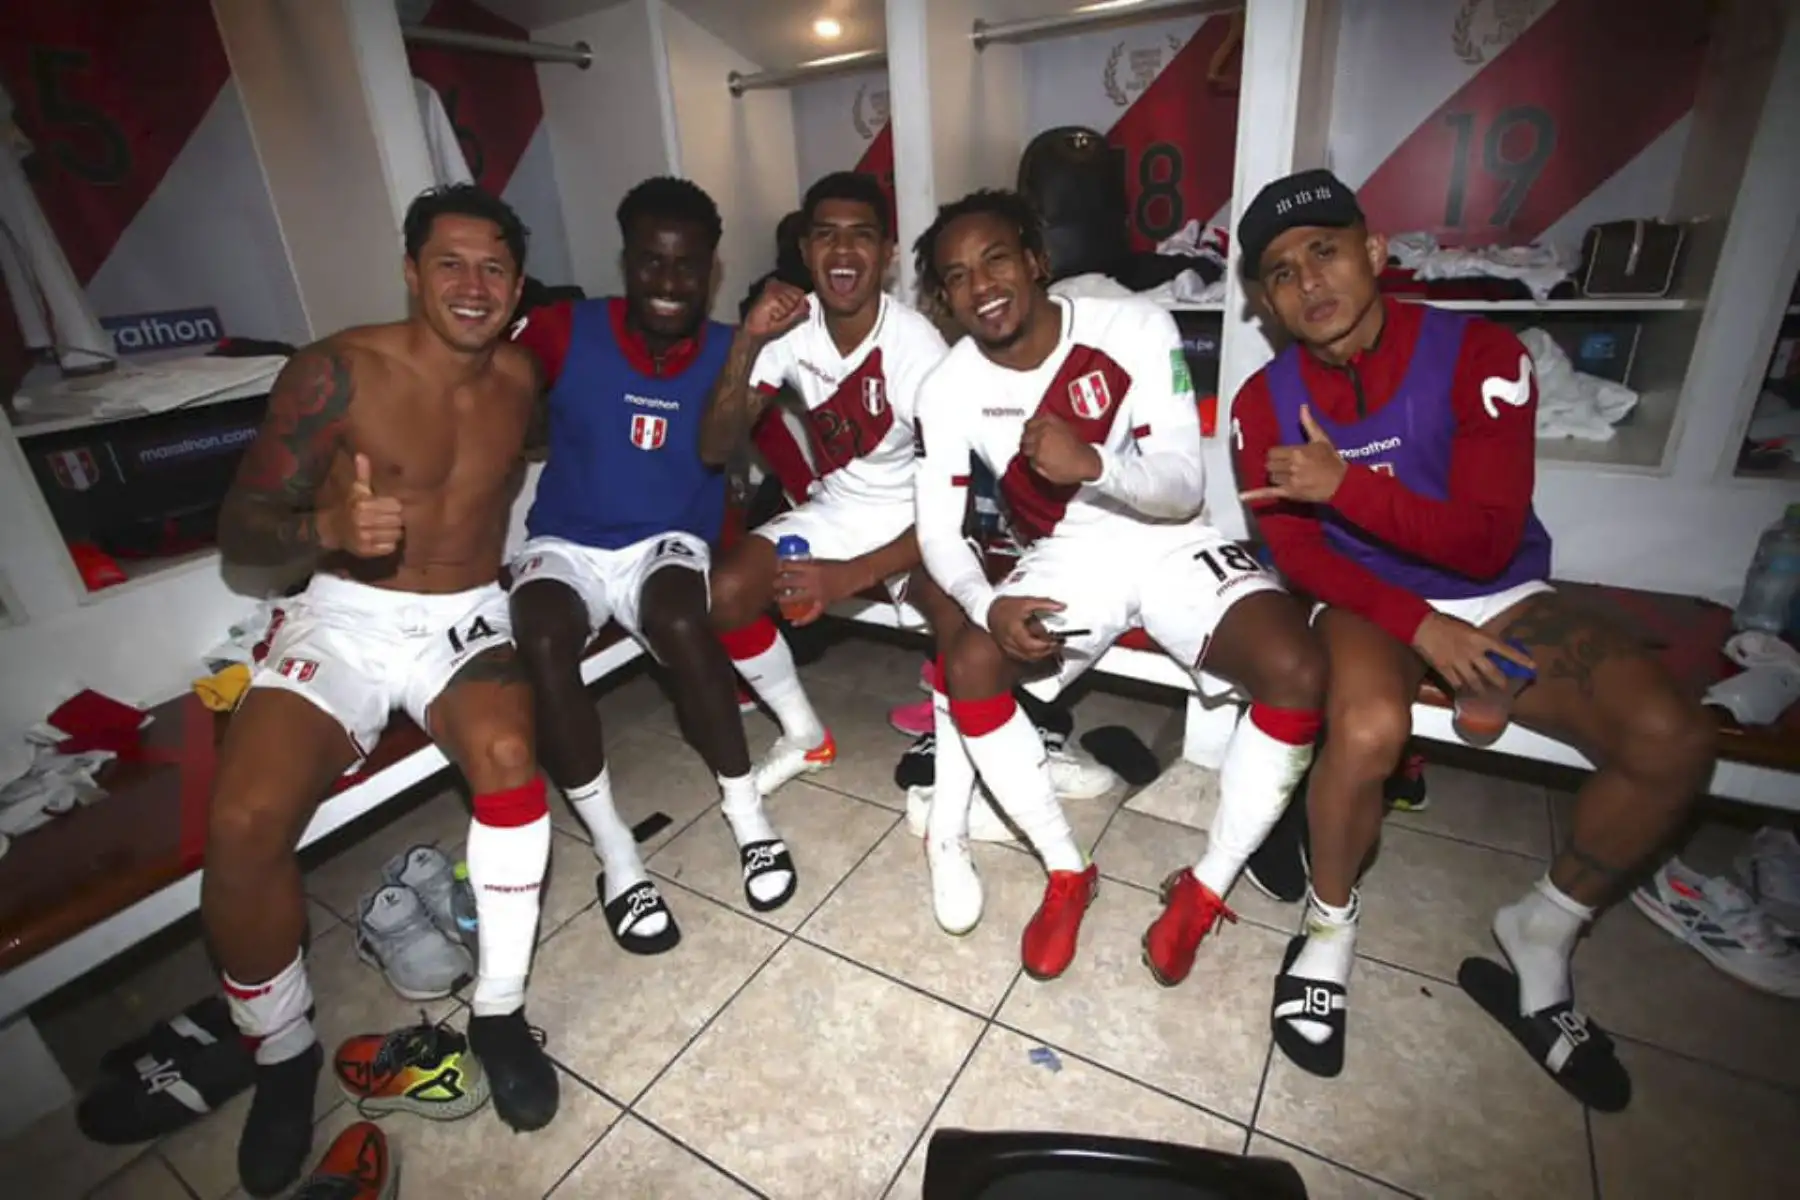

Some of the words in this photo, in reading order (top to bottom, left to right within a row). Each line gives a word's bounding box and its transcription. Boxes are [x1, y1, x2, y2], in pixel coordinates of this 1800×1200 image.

[1444, 106, 1557, 228] 19
[1192, 545, 1261, 582] 18
[447, 614, 500, 654] 14
[747, 846, 776, 870] 25
[627, 886, 658, 917] 25
[1304, 985, 1331, 1016] 19
[1550, 1011, 1591, 1048] 19
